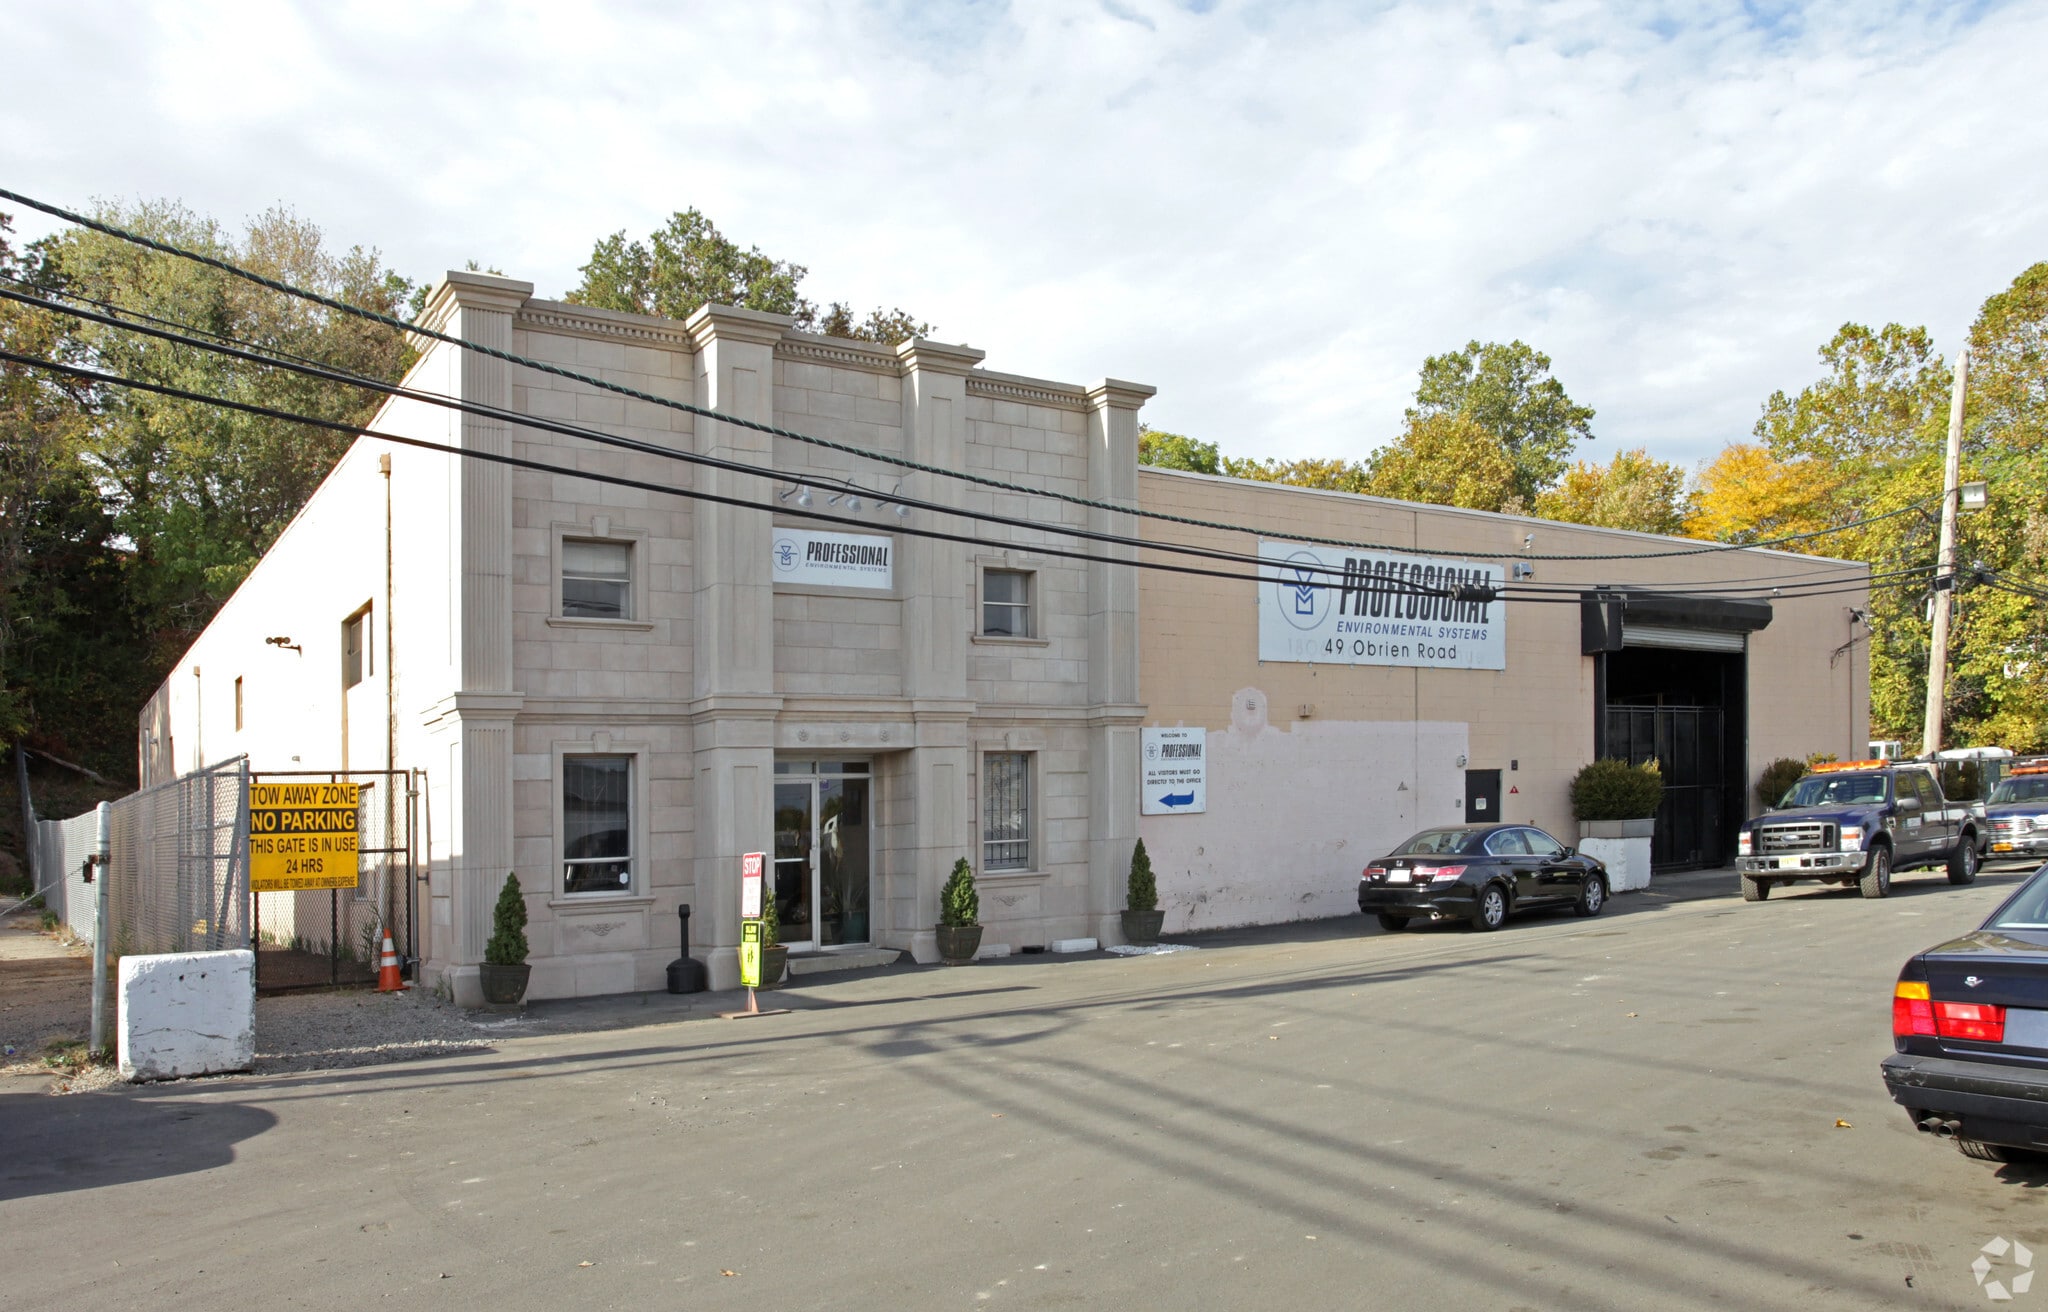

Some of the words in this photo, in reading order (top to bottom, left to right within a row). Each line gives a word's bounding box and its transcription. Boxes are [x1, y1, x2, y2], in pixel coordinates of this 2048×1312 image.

[806, 541, 888, 567] PROFESSIONAL
[805, 562, 857, 571] ENVIRONMENTAL
[1339, 557, 1490, 624] PROFESSIONAL
[1336, 621, 1434, 638] ENVIRONMENTAL
[1438, 628, 1488, 641] SYSTEMS
[1324, 638, 1344, 656] 49
[1353, 639, 1410, 659] Obrien
[1418, 644, 1457, 660] Road
[1161, 744, 1202, 758] PROFESSIONAL
[250, 787, 280, 805] TOW
[283, 786, 319, 805] AWAY
[322, 786, 356, 804] ZONE
[251, 812, 277, 831] NO
[281, 810, 355, 831] PARKING
[249, 838, 273, 854] THIS
[276, 838, 305, 853] GATE
[308, 837, 318, 852] IS
[321, 837, 332, 852] IN
[335, 837, 356, 851] USE
[286, 859, 298, 873] 24
[301, 858, 323, 873] HRS
[744, 857, 760, 874] STOP
